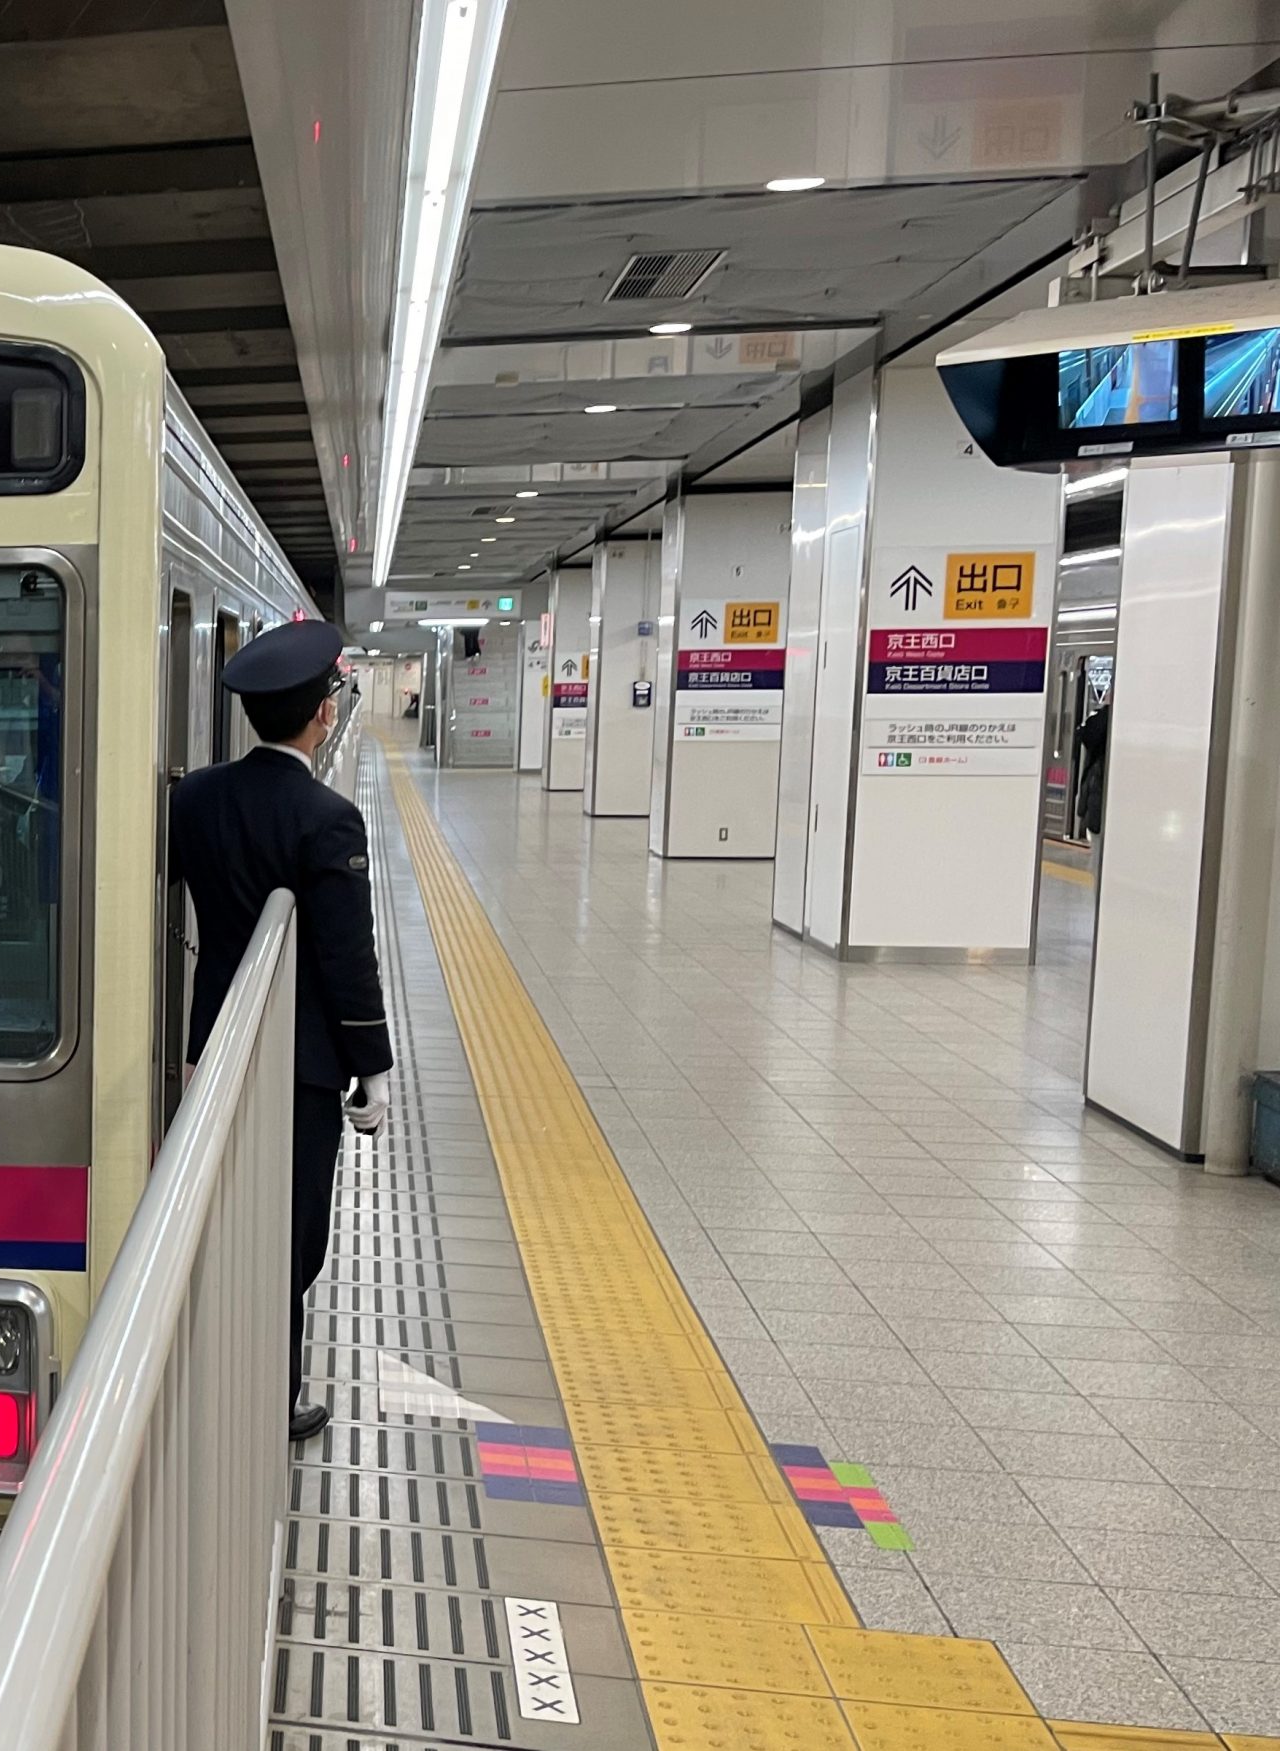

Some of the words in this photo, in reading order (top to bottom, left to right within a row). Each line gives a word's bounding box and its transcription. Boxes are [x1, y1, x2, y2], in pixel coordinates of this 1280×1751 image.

[963, 443, 974, 455] 4
[957, 563, 1022, 593] 出口
[955, 598, 984, 611] Exit
[732, 607, 772, 627] 出口
[887, 633, 956, 650] 京王西口
[885, 665, 988, 682] 京王百貨店口
